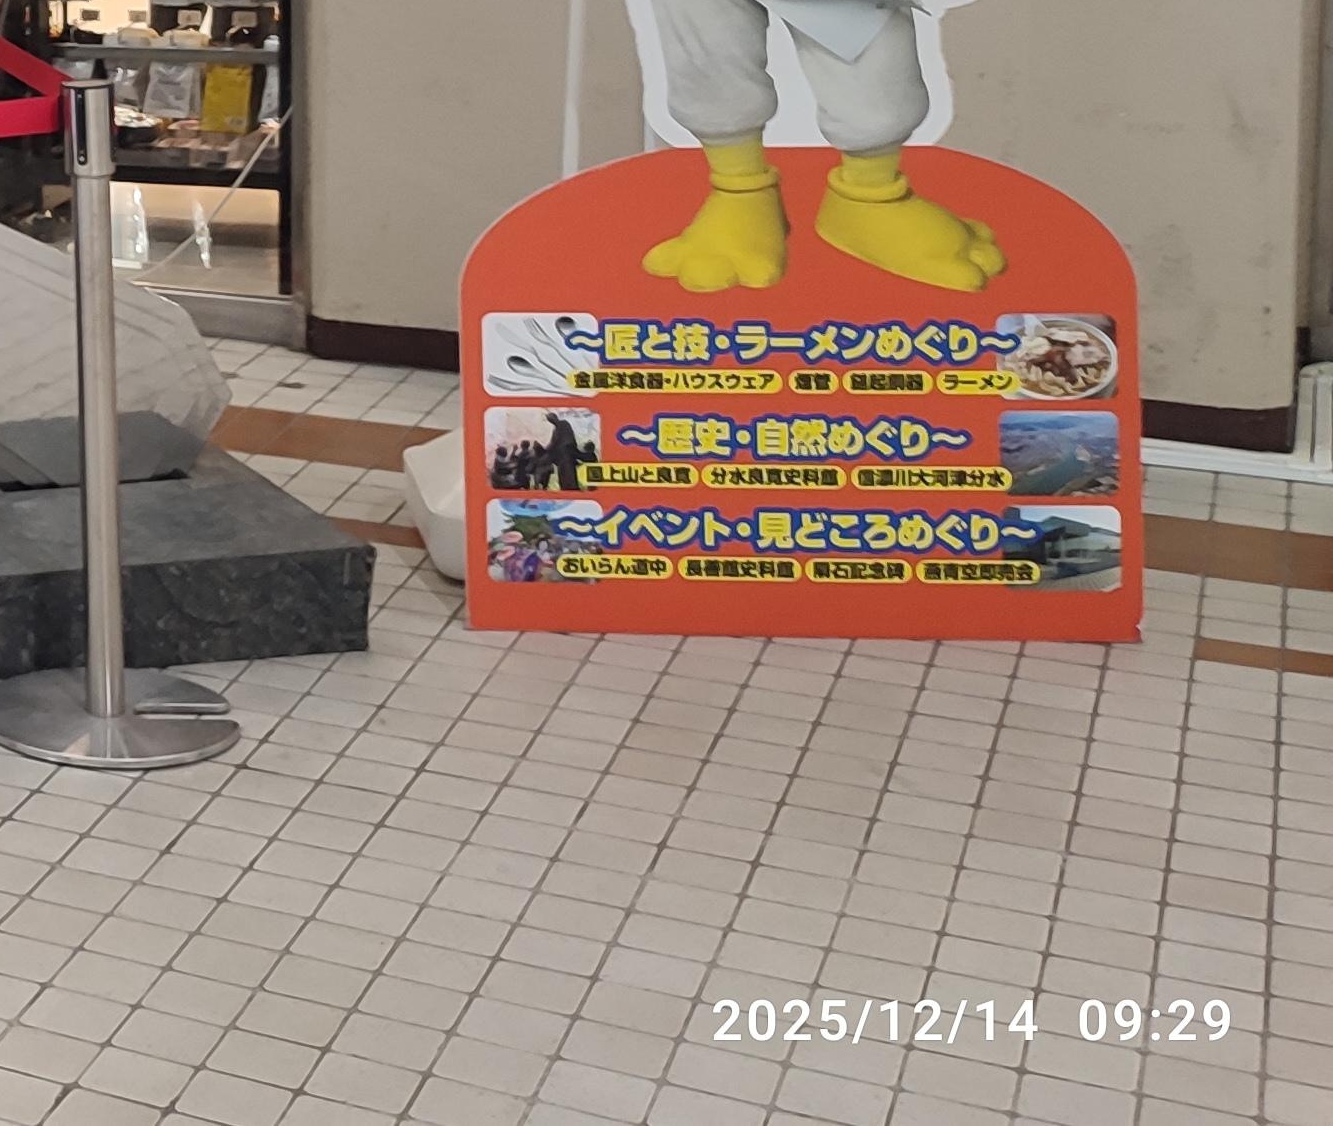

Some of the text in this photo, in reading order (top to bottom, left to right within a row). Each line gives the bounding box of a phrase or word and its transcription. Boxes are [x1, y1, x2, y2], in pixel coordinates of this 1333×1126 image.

[942, 374, 1013, 390] ラーメン
[563, 557, 667, 576] おいらん道中
